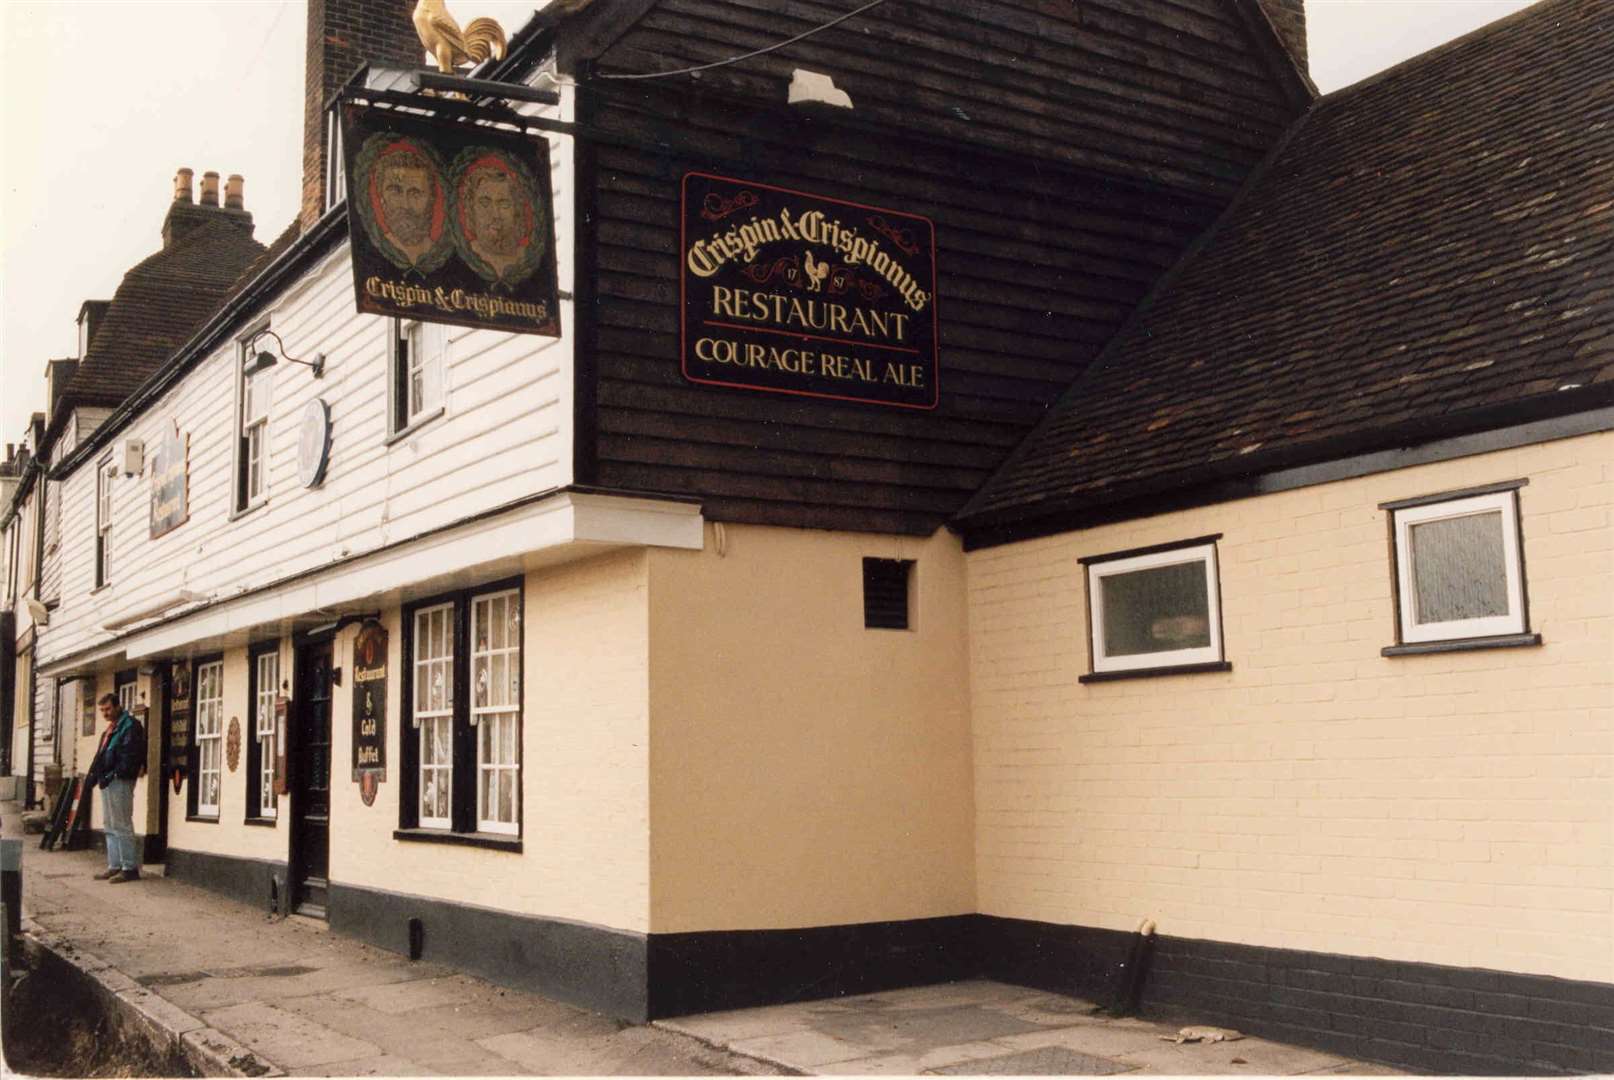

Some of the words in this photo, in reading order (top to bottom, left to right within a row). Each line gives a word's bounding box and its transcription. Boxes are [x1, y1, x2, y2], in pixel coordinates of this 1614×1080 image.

[688, 217, 780, 277] Crispin
[800, 210, 932, 312] Crispianus
[366, 276, 432, 307] Crispin
[435, 287, 454, 312] &
[451, 288, 547, 318] Crispianus
[713, 285, 909, 340] RESTAURANT
[695, 337, 815, 374] COURAGE
[821, 353, 877, 383] REAL
[883, 362, 925, 388] ALE
